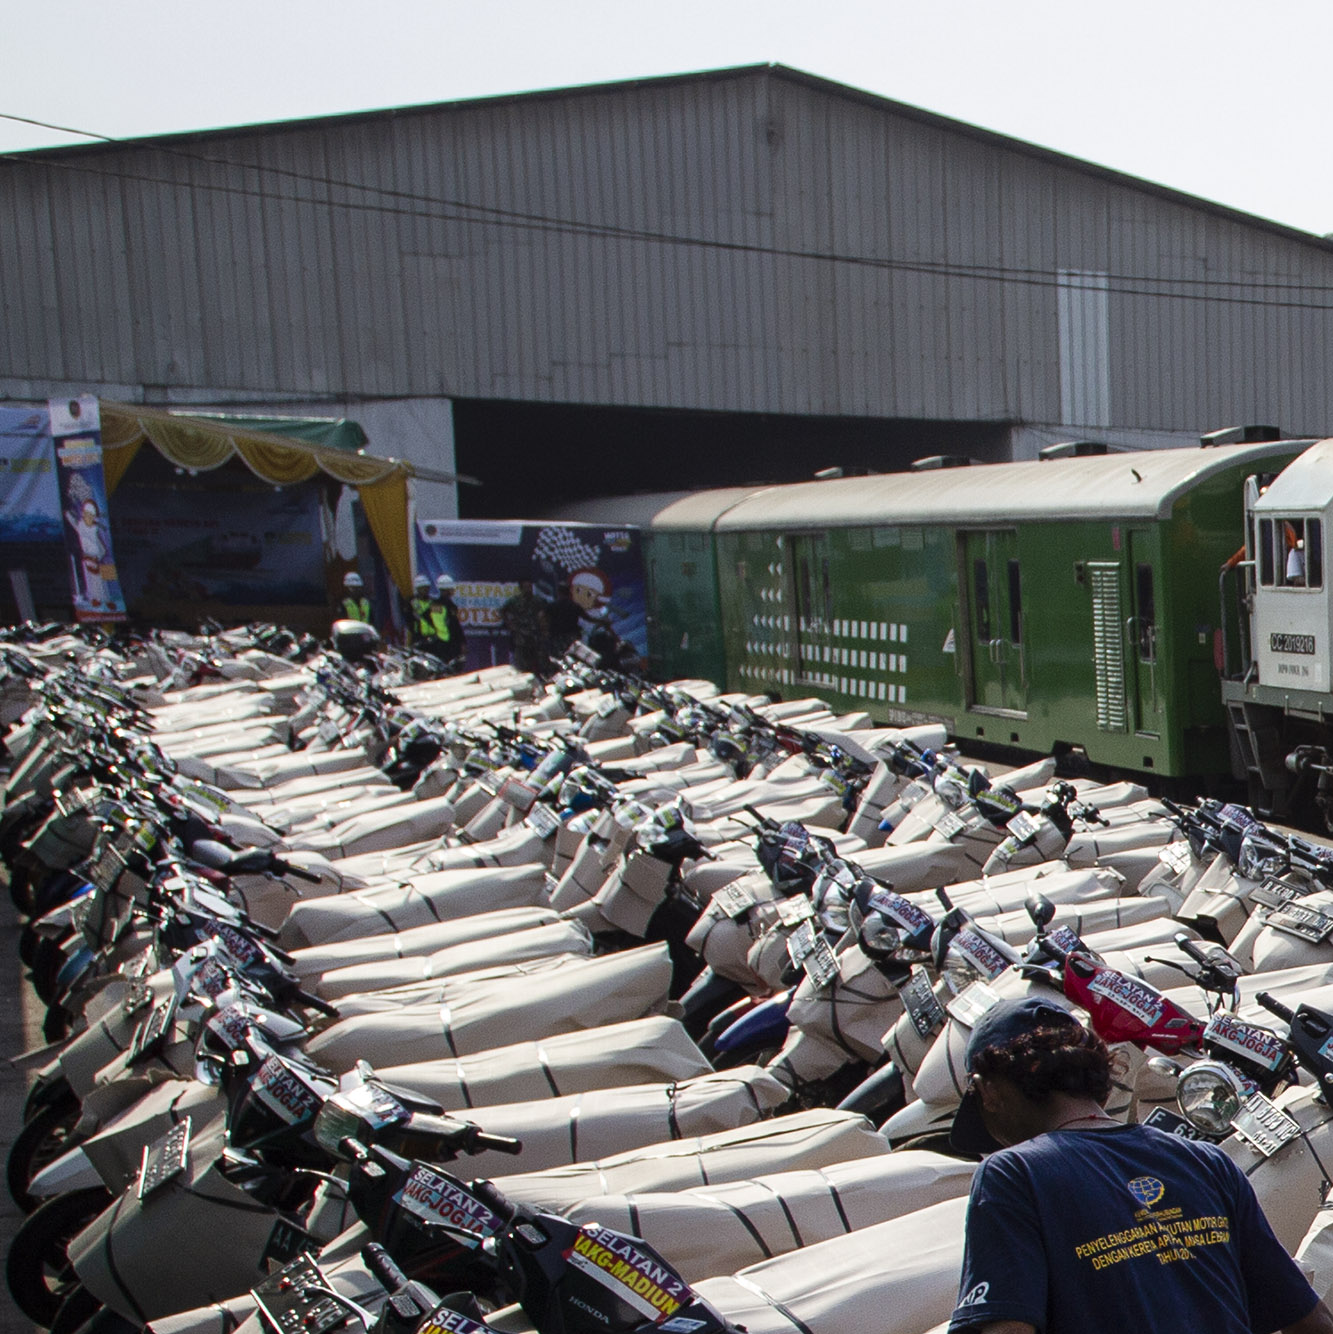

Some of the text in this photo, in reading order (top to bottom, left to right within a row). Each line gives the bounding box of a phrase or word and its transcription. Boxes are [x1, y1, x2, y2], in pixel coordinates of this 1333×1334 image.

[1271, 633, 1283, 650] CC
[1093, 976, 1161, 1022] JAKG-JOGJA
[1101, 970, 1152, 1005] SELATAN
[1152, 998, 1164, 1009] 2
[1209, 1021, 1277, 1062] JAKG-JOGJA
[1271, 1039, 1283, 1051] 2
[1151, 1110, 1166, 1125] F
[415, 1169, 496, 1225] SELATAN 2
[586, 1226, 685, 1297] SELATAN 2
[1091, 1250, 1129, 1271] DENGAN
[569, 1295, 610, 1325] HONDA
